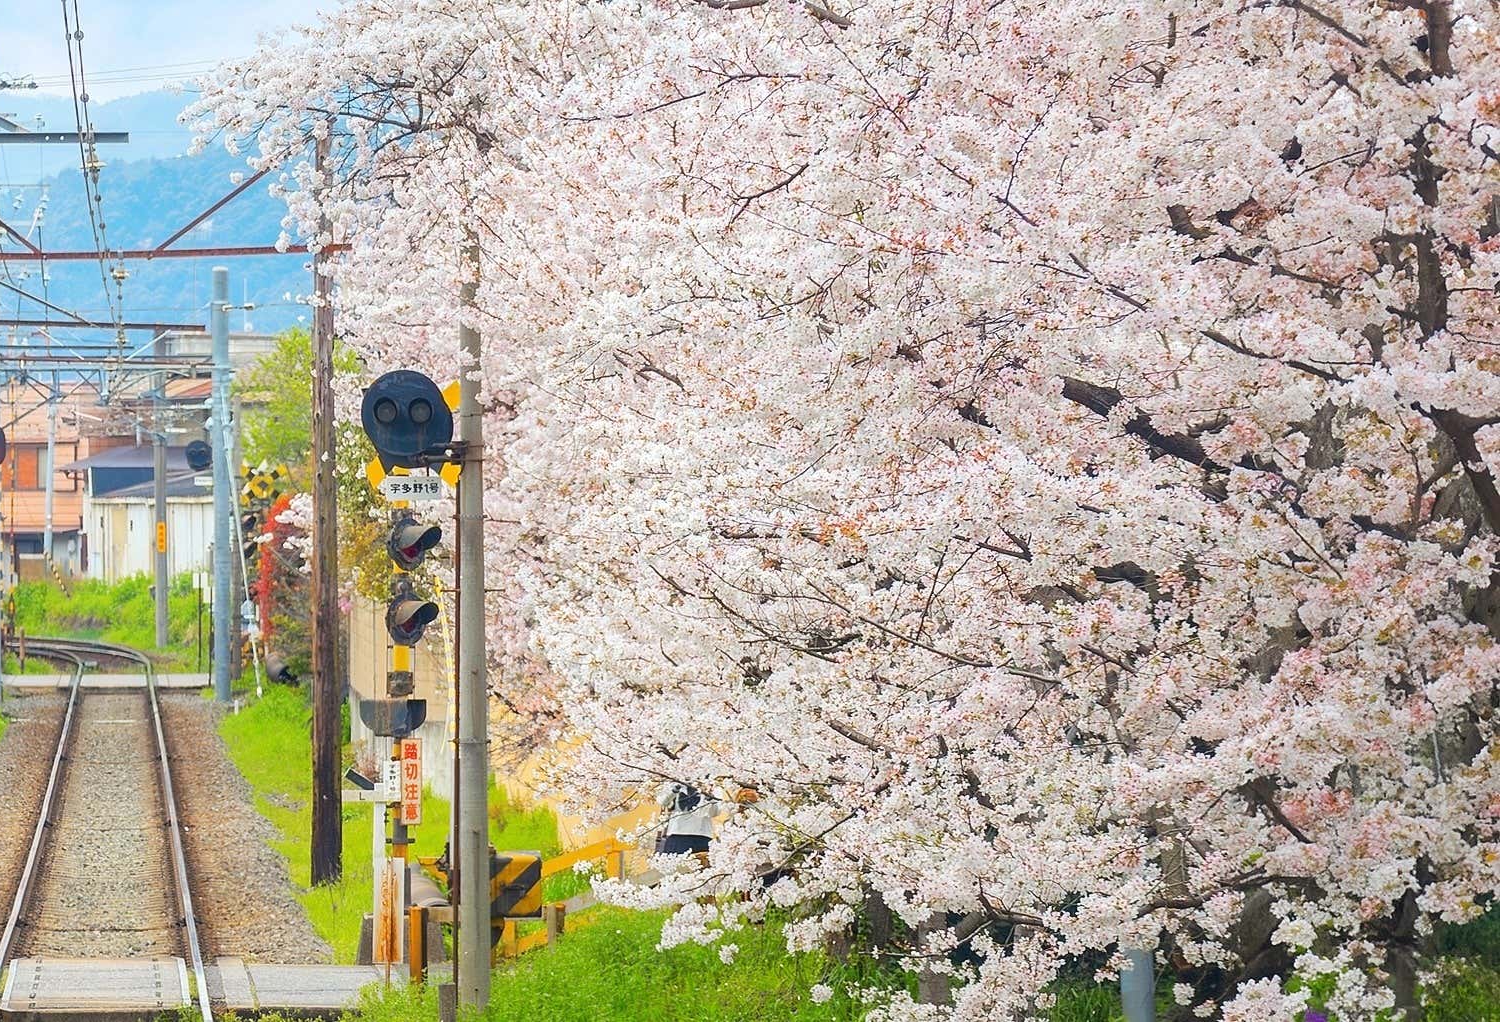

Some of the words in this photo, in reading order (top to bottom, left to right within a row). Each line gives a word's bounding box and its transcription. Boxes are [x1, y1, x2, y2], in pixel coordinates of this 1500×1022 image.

[390, 483, 439, 494] 宇多野1号
[404, 743, 418, 820] 踏切注意
